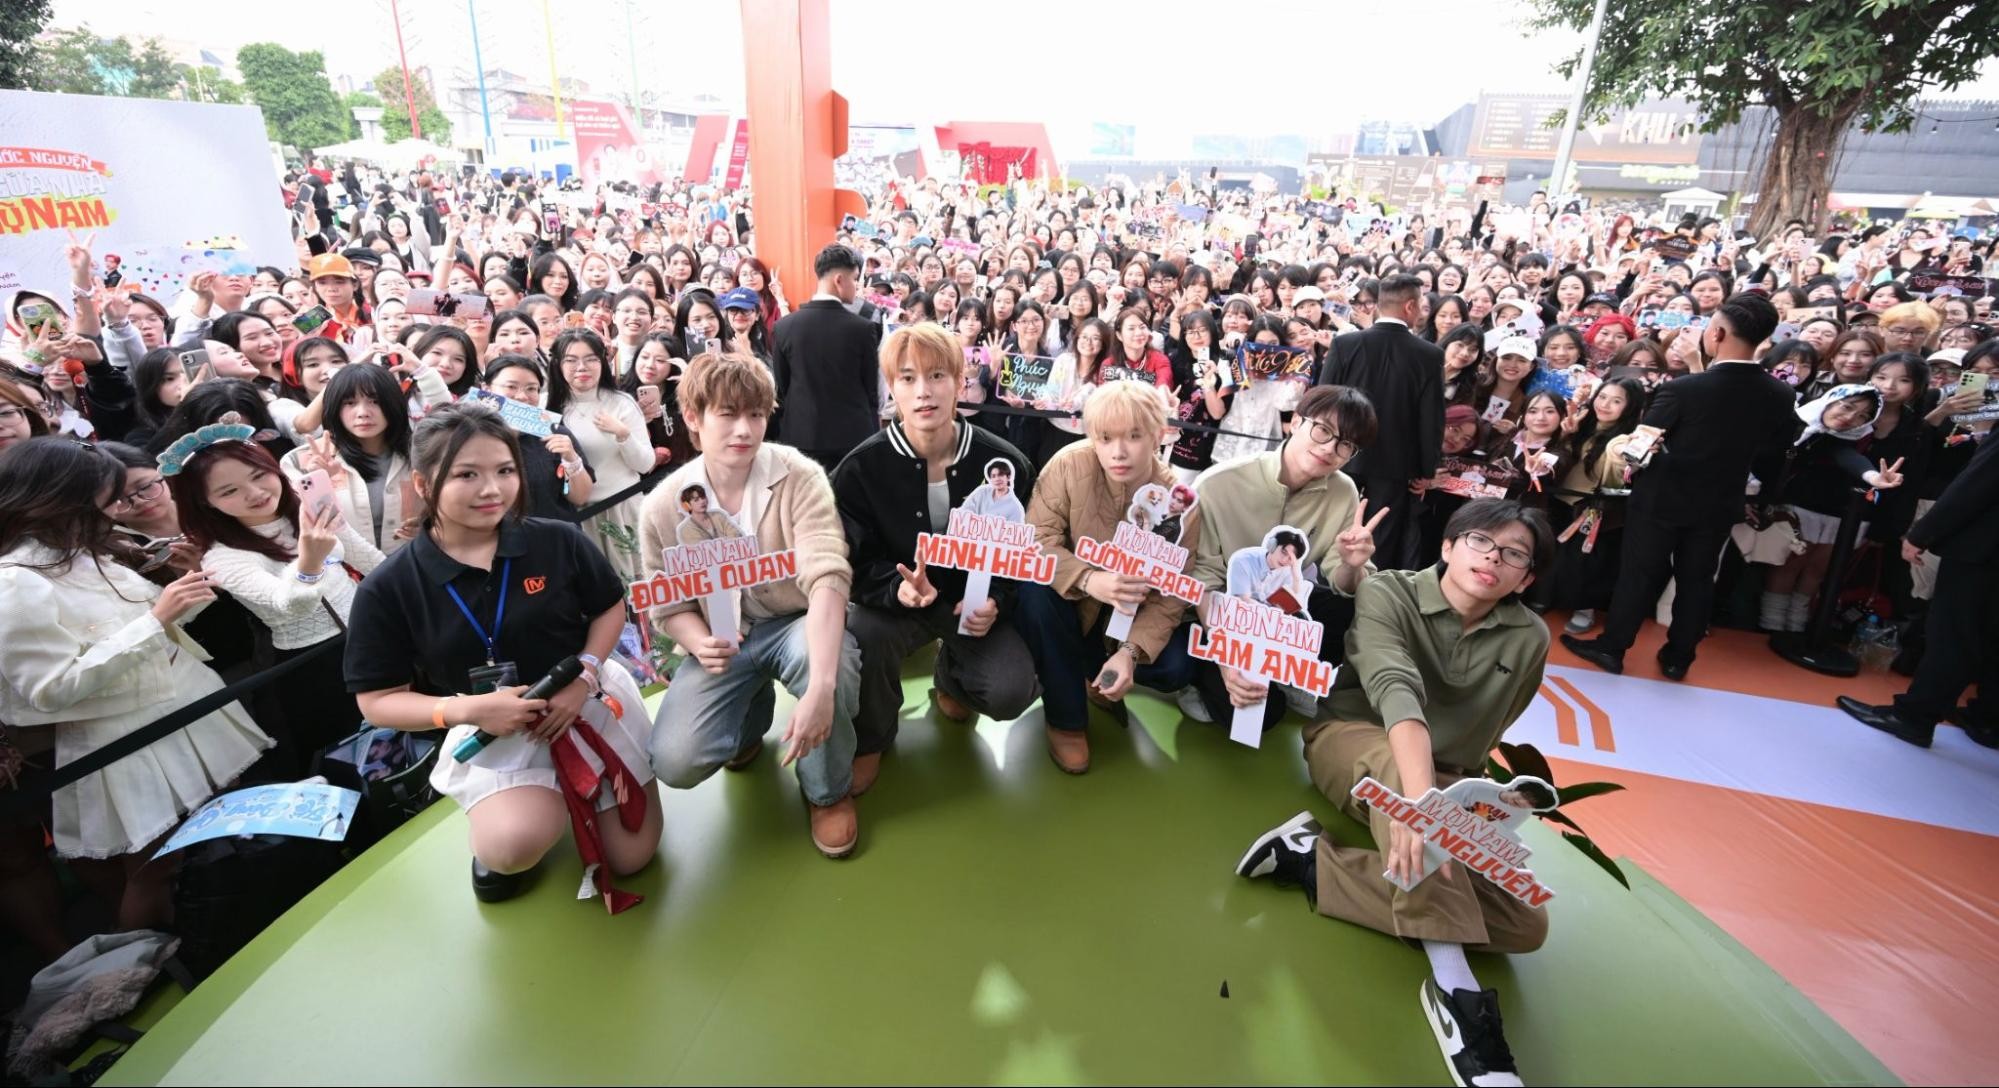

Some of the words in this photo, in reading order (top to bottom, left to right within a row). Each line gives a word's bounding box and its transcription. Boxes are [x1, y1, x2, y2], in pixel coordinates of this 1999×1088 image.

[1620, 112, 1677, 144] KHU
[1013, 355, 1048, 376] Phúc
[631, 570, 714, 610] ĐÔNG
[719, 551, 796, 590] QUAN
[1149, 565, 1204, 602] BẠCH
[1191, 627, 1254, 672] LÂM
[1260, 649, 1331, 695] ANH
[1355, 781, 1434, 834] PHÚC
[1429, 826, 1554, 907] NGUYÊN
